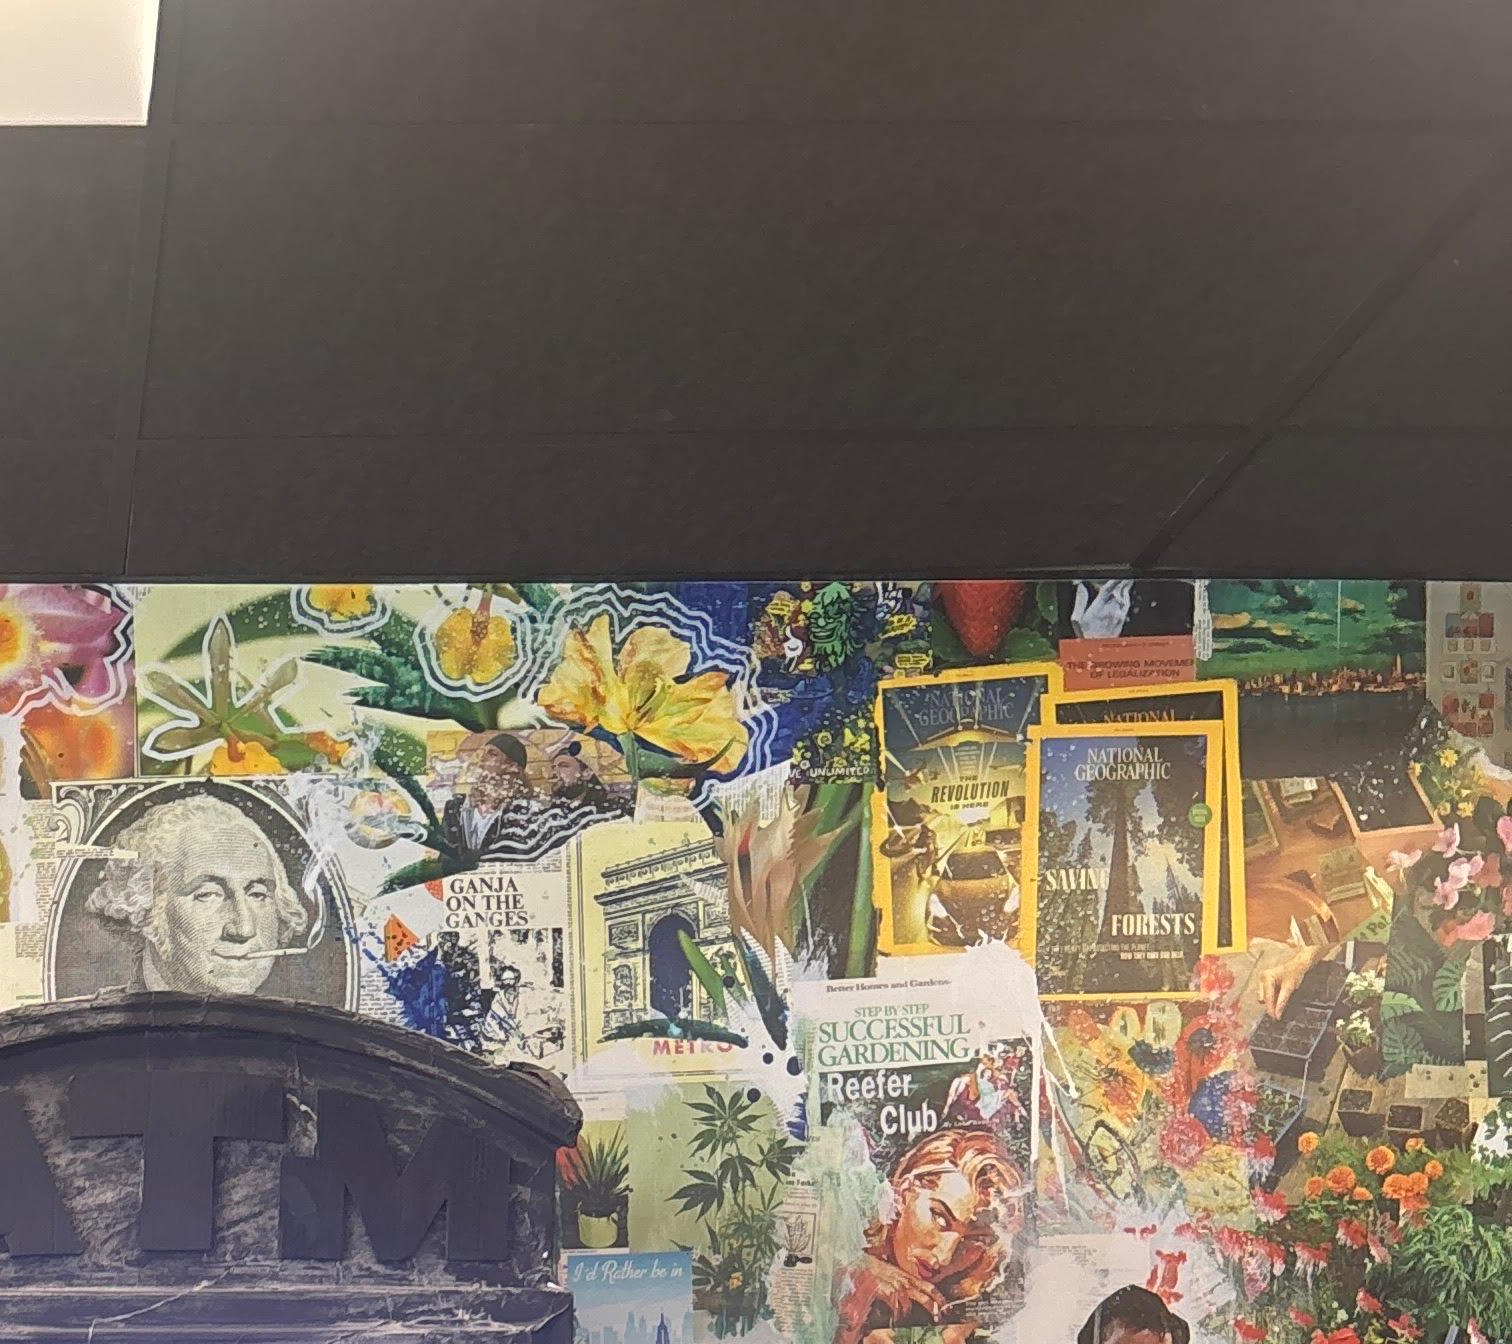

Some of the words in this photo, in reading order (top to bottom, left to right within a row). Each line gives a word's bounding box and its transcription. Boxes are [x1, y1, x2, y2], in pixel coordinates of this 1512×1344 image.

[1067, 660, 1089, 669] THE
[1107, 668, 1180, 679] LEGALIZATION
[925, 687, 1004, 706] NATIONAL
[1087, 747, 1164, 764] NATIONAL
[809, 766, 870, 778] UNLIMITED
[1074, 762, 1172, 782] GEOGRAPHIC
[931, 779, 1010, 804] REVOLUTION
[450, 877, 518, 894] GANJA
[445, 895, 480, 912] ON
[482, 893, 525, 911] THE
[445, 910, 529, 929] GANGES
[1111, 913, 1196, 937] FORESTS
[826, 983, 854, 993] Better
[855, 982, 889, 992] Homes
[890, 980, 909, 990] and
[854, 1006, 882, 1018] STEP
[884, 1004, 900, 1016] BY
[901, 1003, 929, 1015] STEP
[818, 1013, 971, 1044] SUCCESSFUL
[817, 1036, 969, 1067] GARDENING
[826, 1068, 913, 1101] Reefer
[879, 1102, 938, 1135] Club
[601, 1259, 649, 1285] Rather
[651, 1258, 668, 1279] be
[671, 1262, 684, 1278] in
